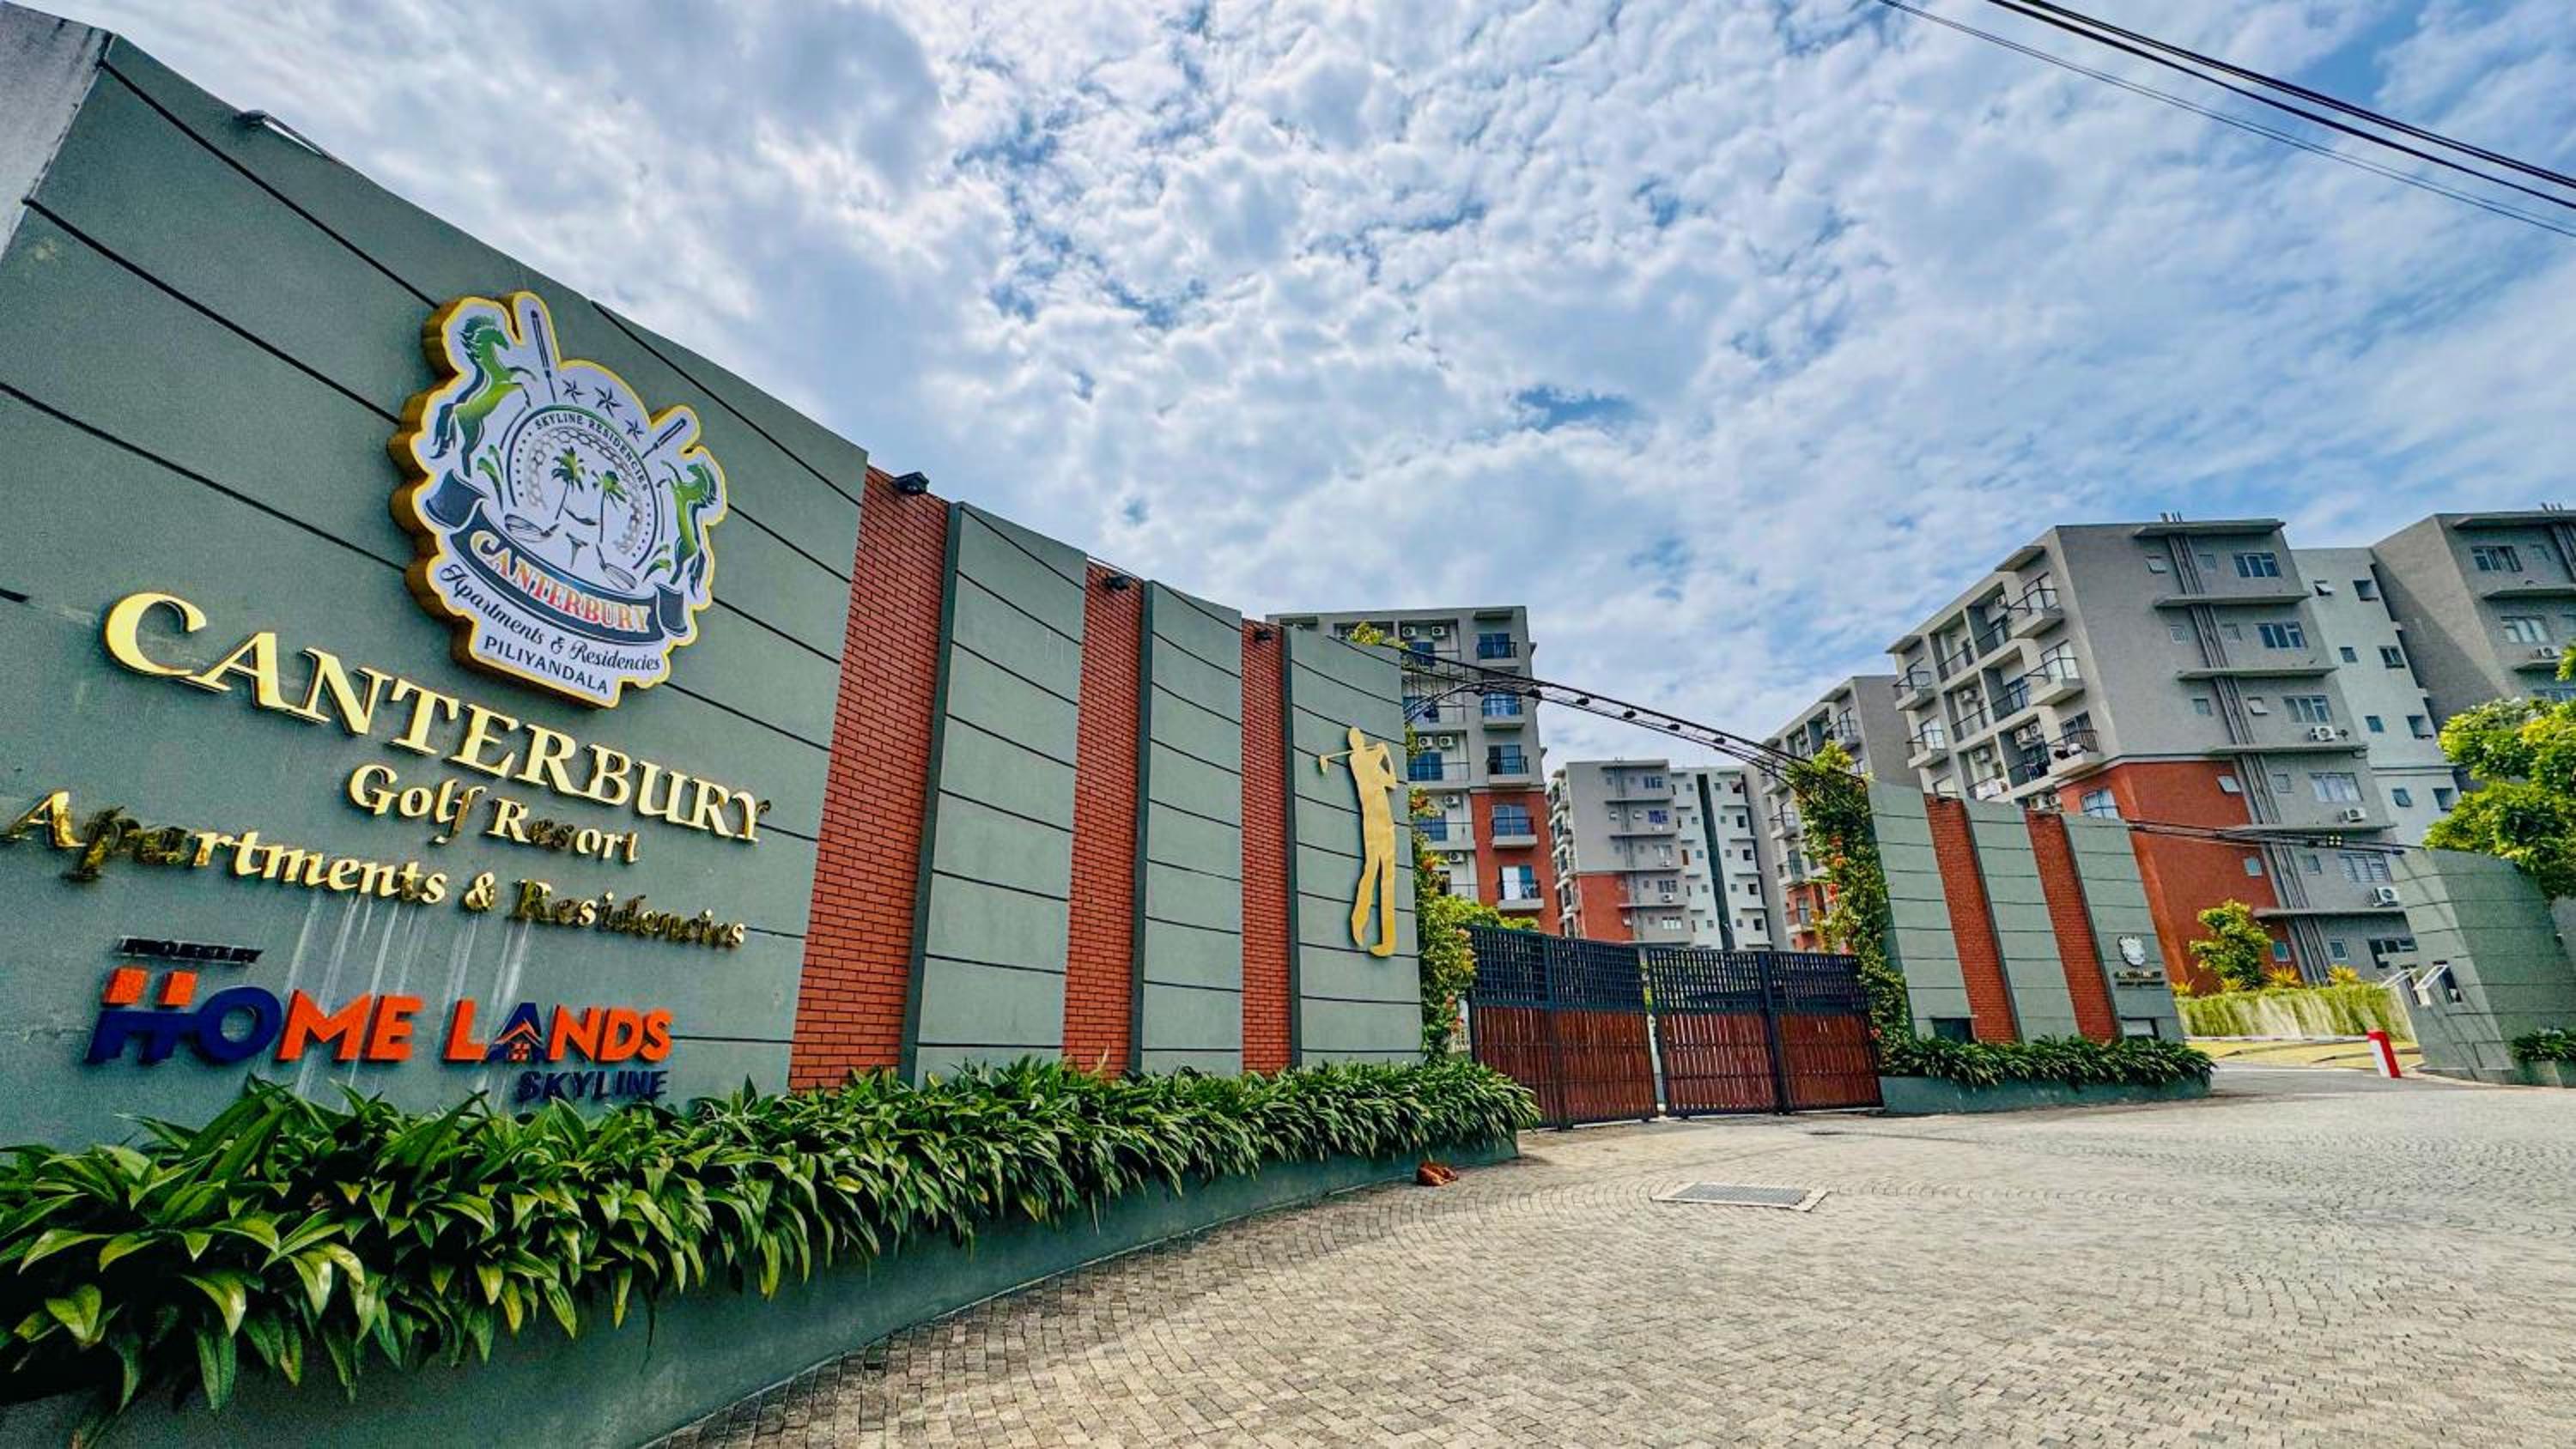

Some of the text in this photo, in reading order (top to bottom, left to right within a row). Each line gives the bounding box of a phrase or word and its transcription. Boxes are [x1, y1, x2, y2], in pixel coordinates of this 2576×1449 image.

[535, 412, 584, 430] SKYLINE
[438, 563, 660, 670] Apartments & Residencies
[471, 529, 653, 634] CANTERBURY
[483, 635, 609, 694] PILIYANDALA
[103, 591, 771, 843] CANTERBURY
[347, 764, 640, 864] Golf Resort
[2, 790, 747, 948] Apartments & Residencies
[84, 966, 674, 1064] HOME LANDS
[518, 1070, 669, 1100] SKYLINE
